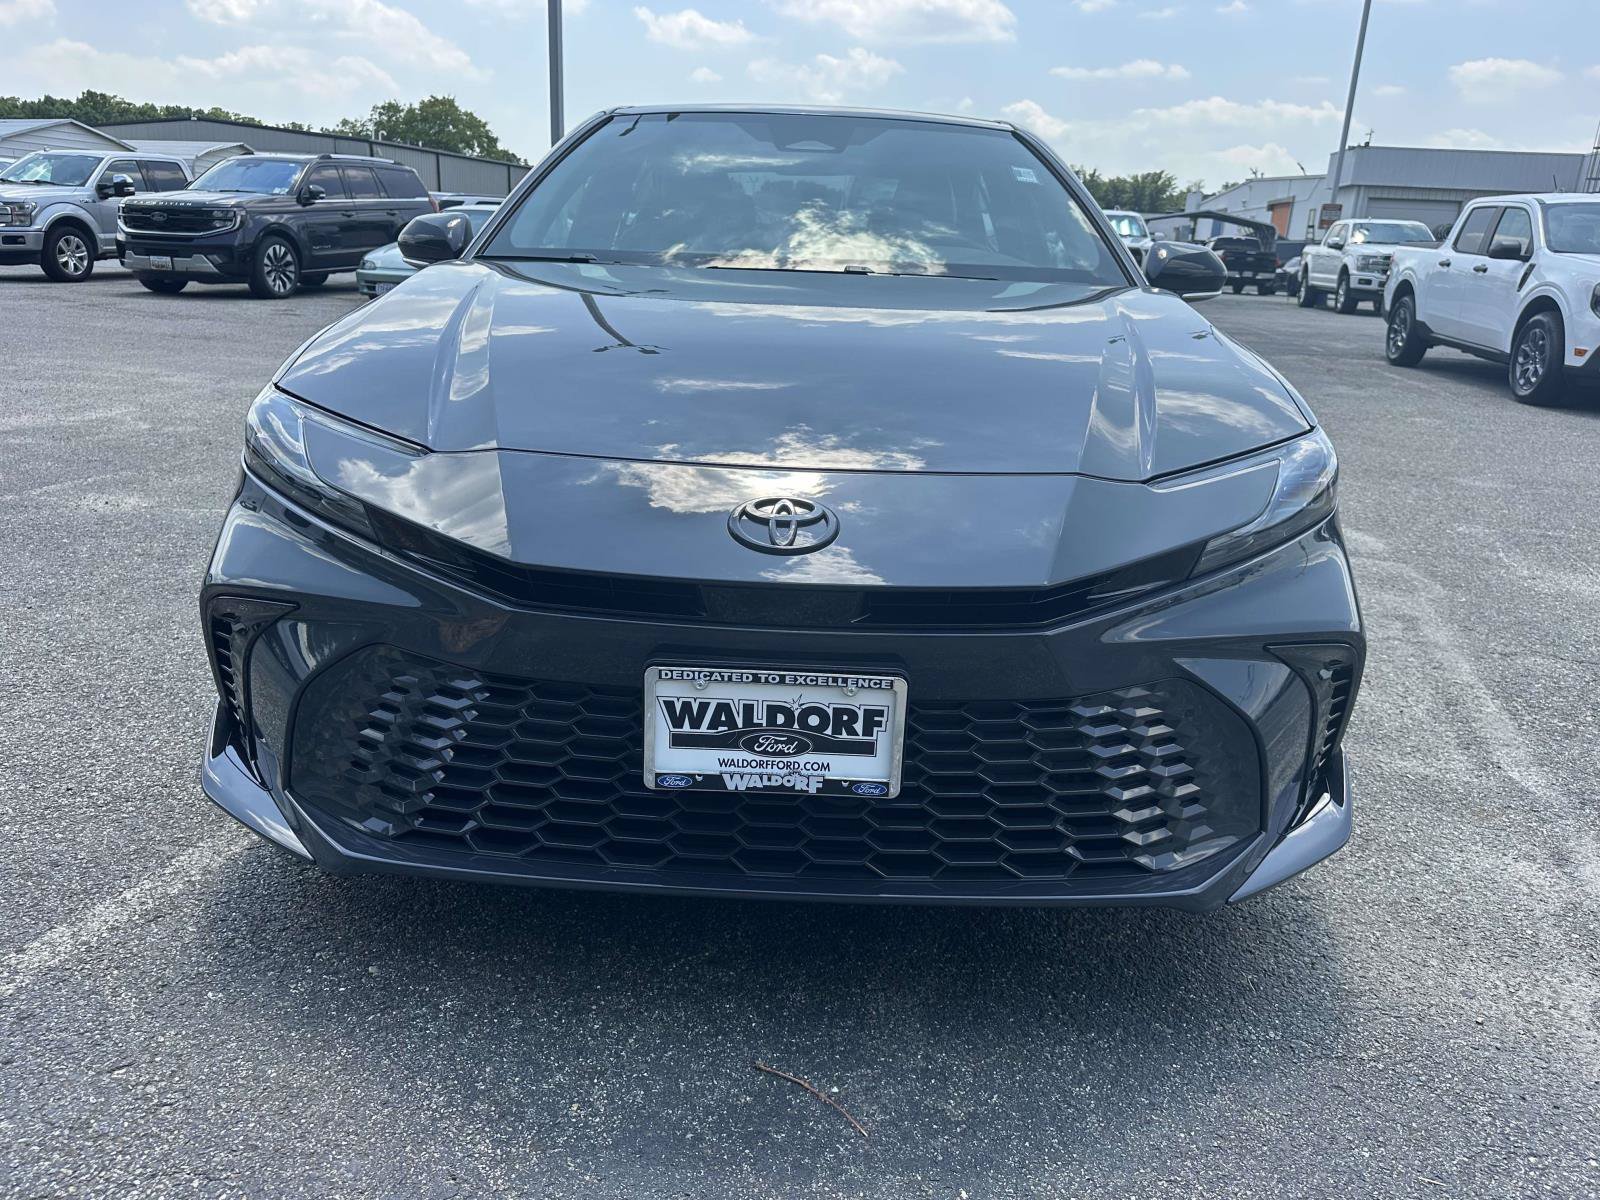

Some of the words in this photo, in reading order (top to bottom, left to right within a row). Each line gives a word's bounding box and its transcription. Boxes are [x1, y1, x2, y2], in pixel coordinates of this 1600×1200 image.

[661, 669, 753, 682] DEDICATED
[758, 674, 780, 683] TO
[785, 675, 892, 689] EXCELLENCE
[656, 696, 889, 738] WALDORF
[754, 735, 798, 754] Ford
[717, 757, 831, 772] WALDORFFORD.COM
[721, 772, 825, 794] WALDORF
